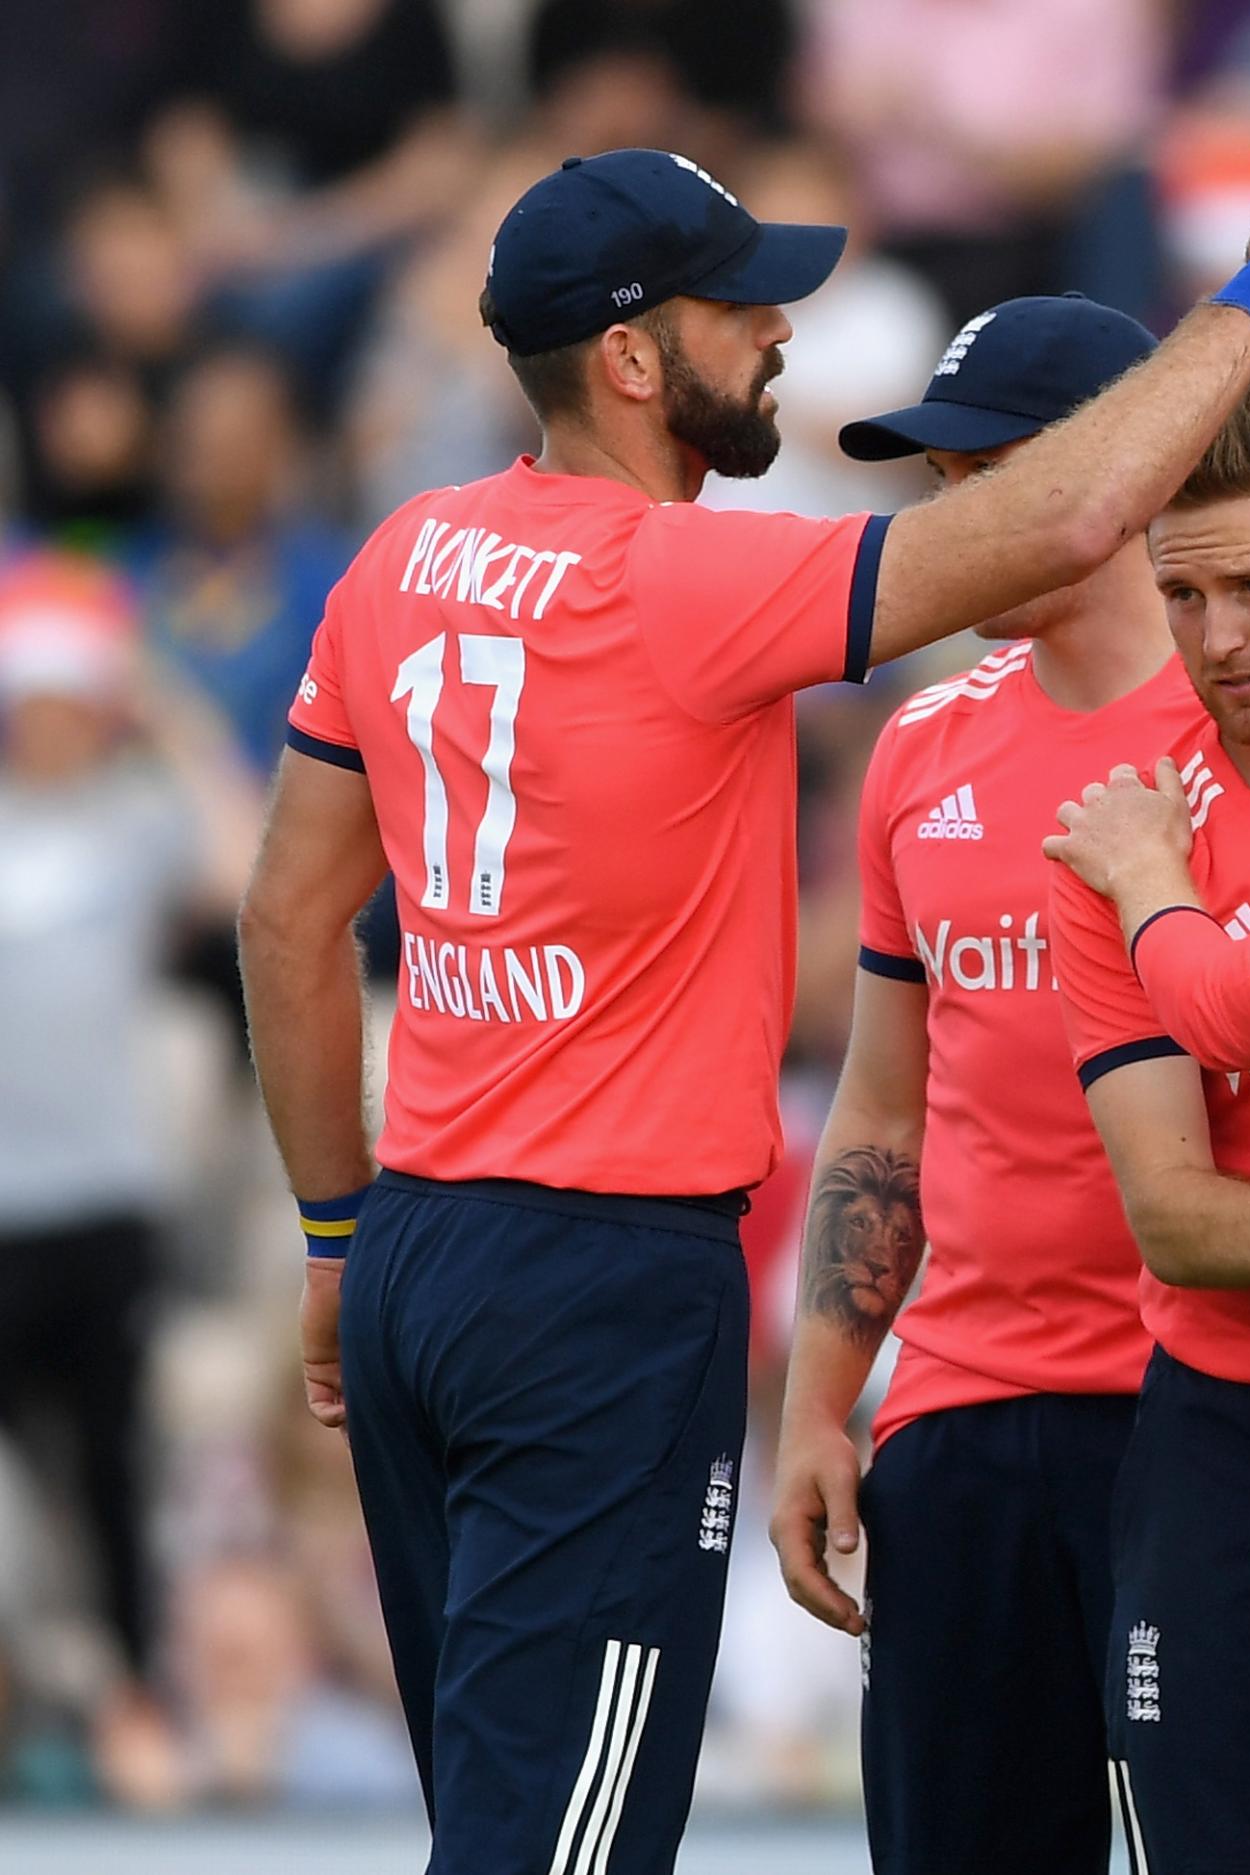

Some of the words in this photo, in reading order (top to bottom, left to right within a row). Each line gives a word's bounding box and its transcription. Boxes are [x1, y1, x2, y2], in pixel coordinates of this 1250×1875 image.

[611, 282, 643, 308] 190
[400, 518, 582, 620] PLUNKETT
[391, 631, 524, 916] 17
[917, 818, 984, 840] adidas
[403, 932, 586, 1022] ENGLAND
